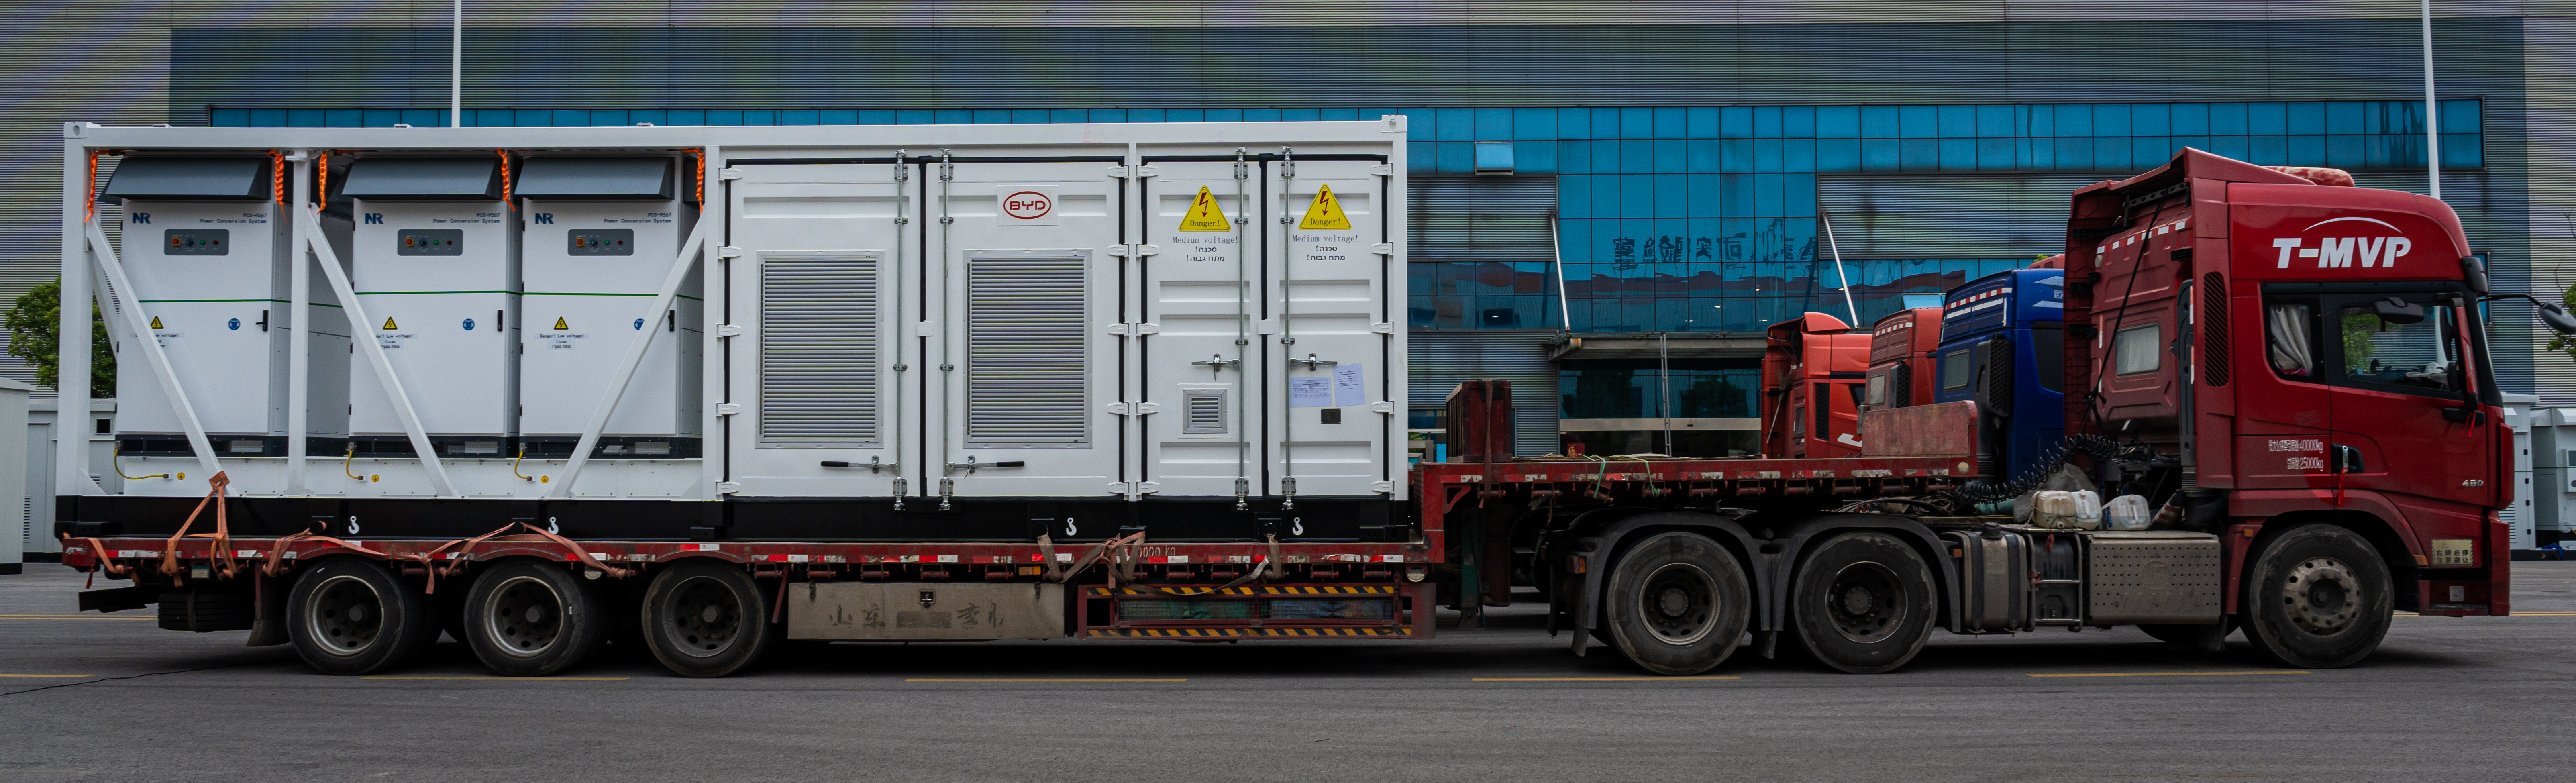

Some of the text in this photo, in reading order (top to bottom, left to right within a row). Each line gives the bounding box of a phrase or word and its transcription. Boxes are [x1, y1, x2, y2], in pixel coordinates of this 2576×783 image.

[1009, 200, 1046, 210] BYD
[133, 212, 151, 224] NR
[365, 213, 384, 224] NR
[535, 213, 554, 224] NR
[1310, 218, 1340, 226] Danger!
[1190, 220, 1220, 228] Danger!
[1203, 236, 1238, 244] voltage!
[1324, 234, 1358, 243] voltage!
[2272, 237, 2411, 269] T-MVP
